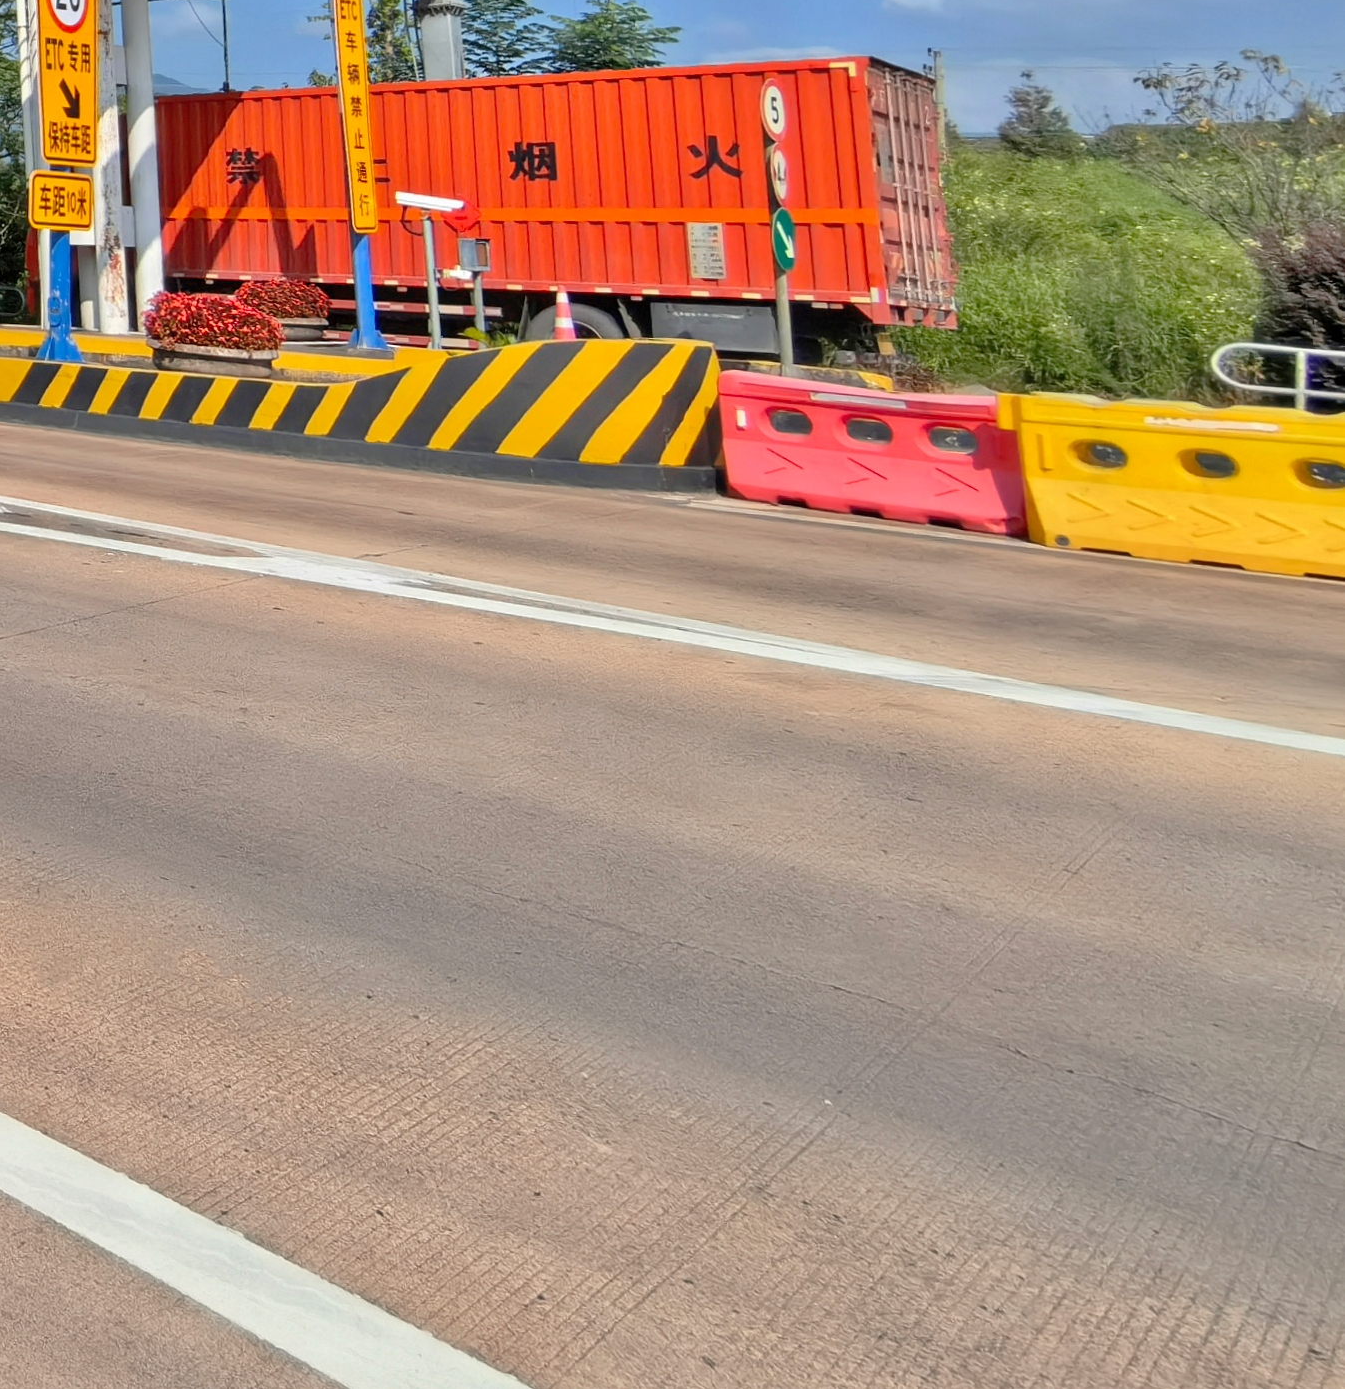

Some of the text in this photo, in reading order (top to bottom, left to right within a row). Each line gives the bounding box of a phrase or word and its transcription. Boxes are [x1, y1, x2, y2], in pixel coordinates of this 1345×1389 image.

[45, 37, 91, 73] ETC 专用
[771, 97, 779, 124] 5
[48, 121, 91, 154] 保持车距
[226, 147, 261, 184] 禁
[508, 142, 558, 181] 烟
[687, 135, 743, 179] 火
[38, 183, 87, 218] 车距10米
